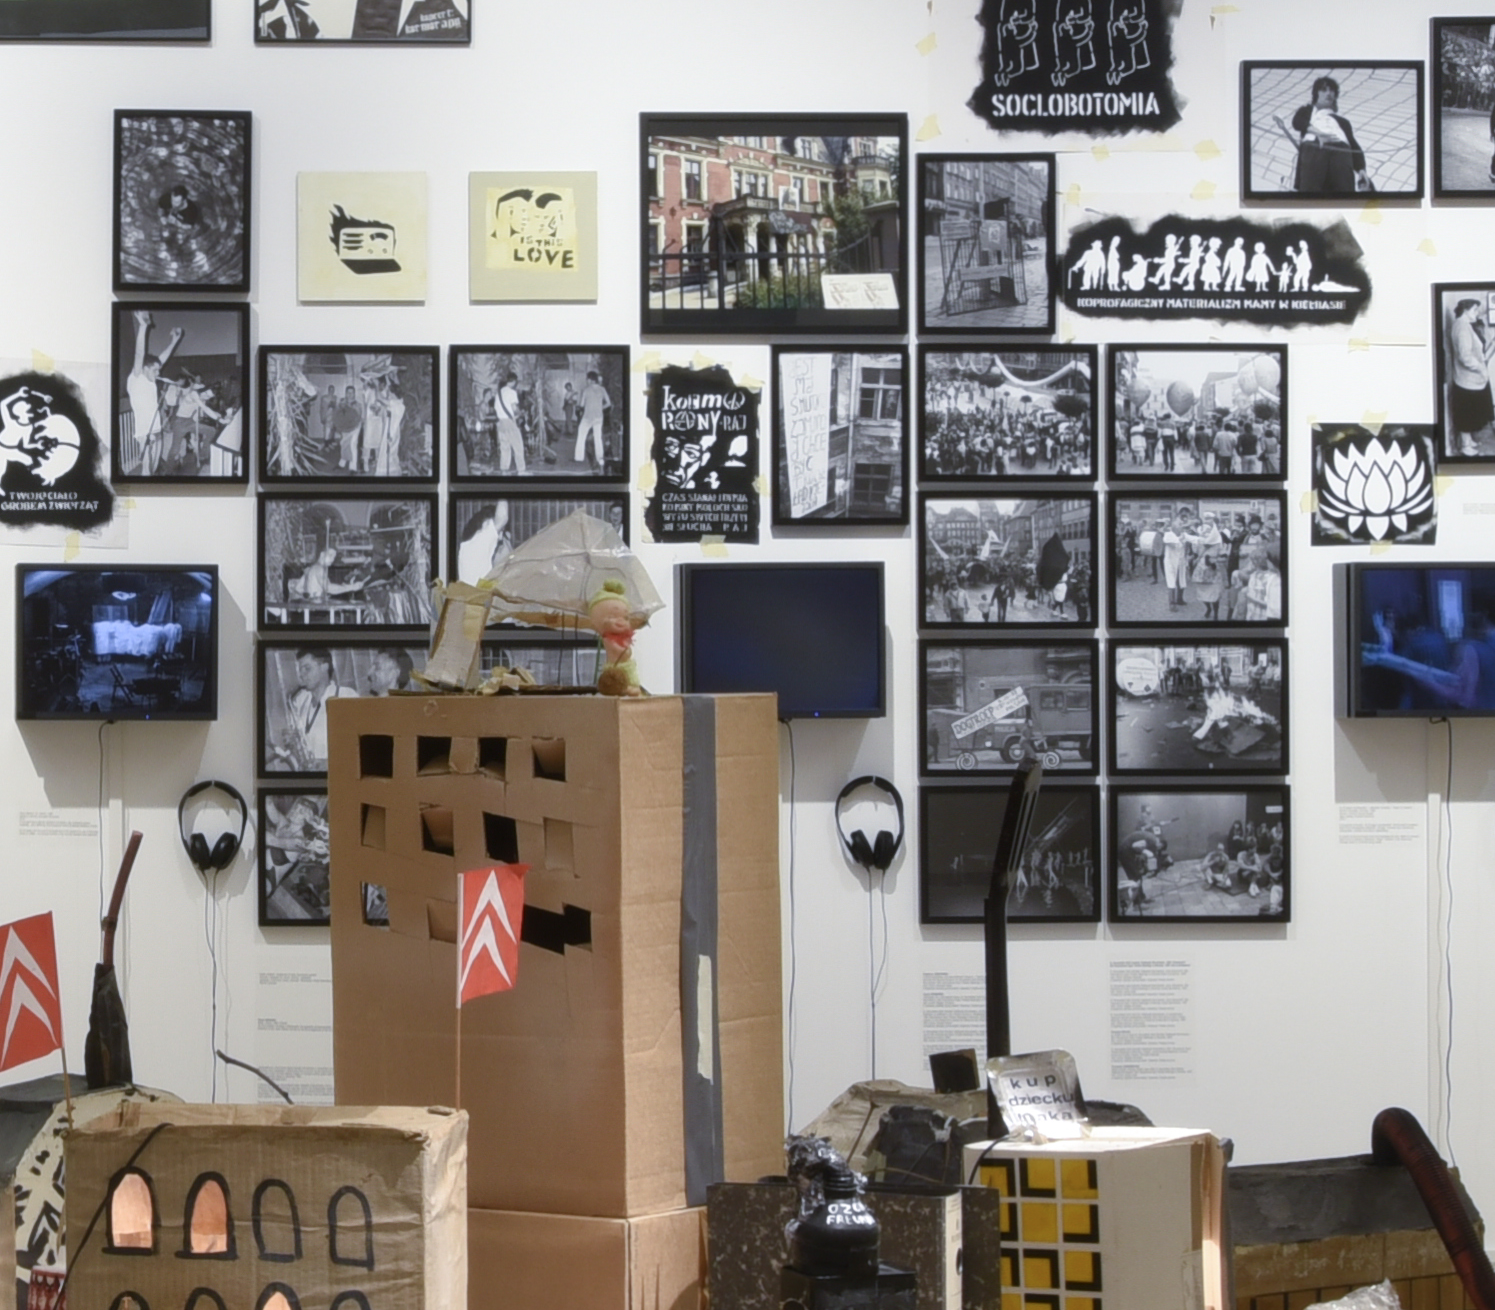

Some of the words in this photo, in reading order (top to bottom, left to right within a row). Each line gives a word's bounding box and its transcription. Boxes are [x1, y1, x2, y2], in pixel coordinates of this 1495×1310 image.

[992, 92, 1160, 116] SOCLOBOTOMIA
[513, 247, 574, 269] LOVE
[1166, 297, 1241, 309] MATERIALIZM
[1010, 1074, 1056, 1089] kup
[1009, 1093, 1074, 1107] dziecku
